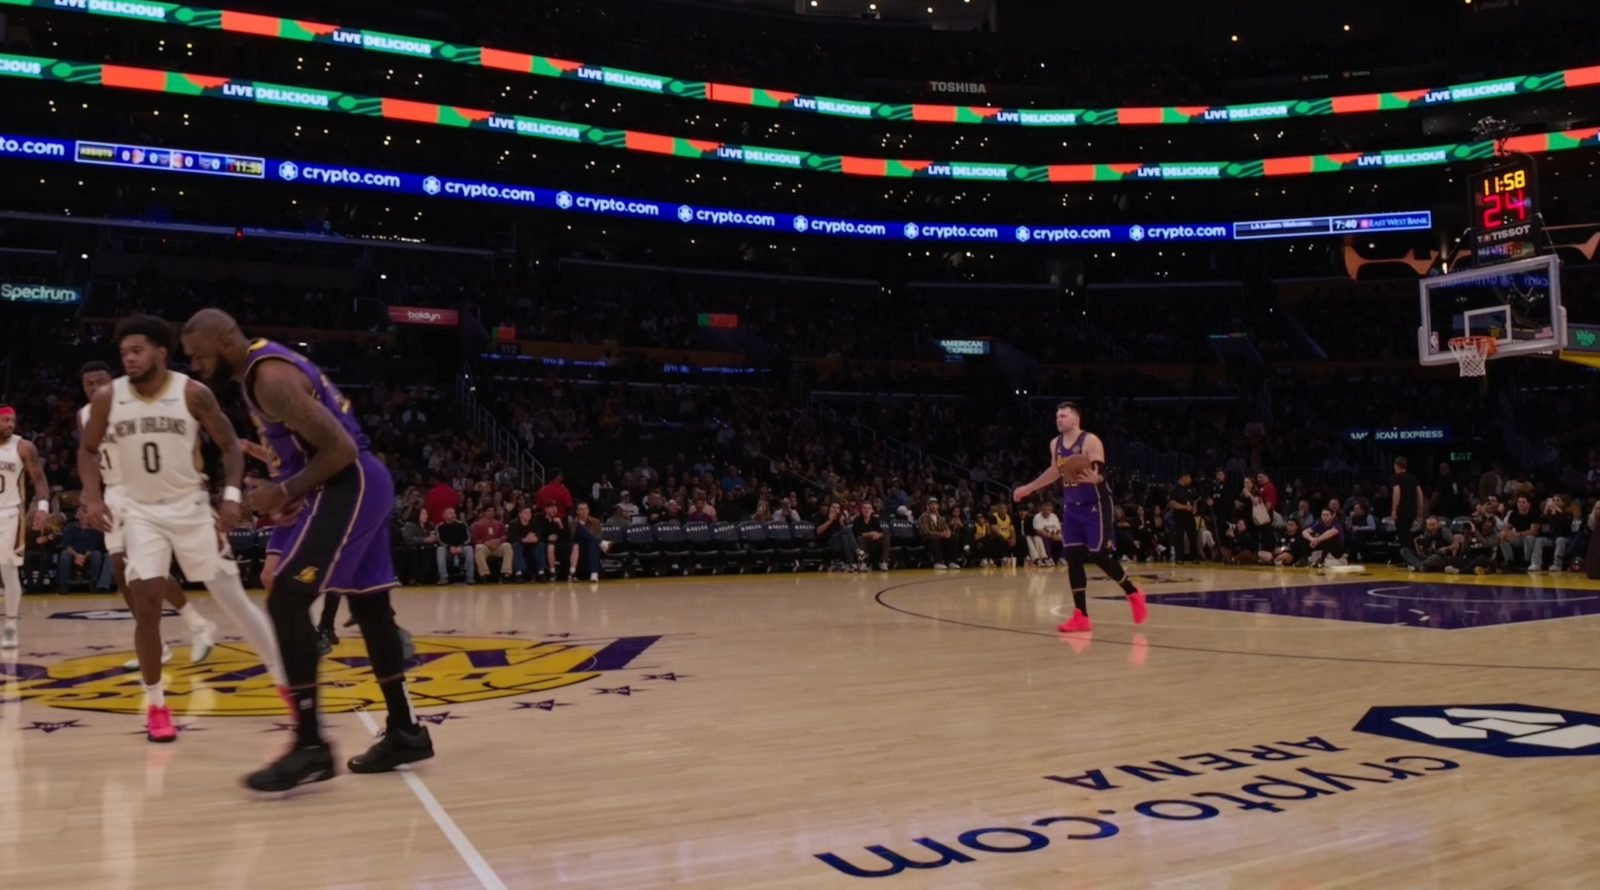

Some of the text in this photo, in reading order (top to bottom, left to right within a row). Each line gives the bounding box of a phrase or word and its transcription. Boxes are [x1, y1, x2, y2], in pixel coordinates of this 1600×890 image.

[88, 0, 165, 18] DELICIOUS
[332, 29, 431, 54] LIVE DELICIOUS
[577, 66, 662, 91] LIVE DELICIOUS
[930, 81, 986, 94] TOSHIBA
[223, 82, 329, 107] LIVE DELICIOUS
[1424, 81, 1516, 103] LIVE DELICIOUS
[793, 96, 871, 116] LIVE DELICIOUS
[1204, 104, 1288, 120] LIVE DELICIOUS
[996, 111, 1076, 124] LIVE DELICIOUS
[488, 116, 580, 139] LIVE DELICIOUS
[720, 147, 801, 166] LIVE DELICIOUS
[1357, 149, 1446, 166] LIVE DELICIOUS
[303, 167, 400, 187] crypto.com
[927, 164, 1008, 178] LIVE DELICIOUS
[1137, 165, 1219, 178] LIVE DELICIOUS
[444, 182, 535, 201] crypto.com
[1484, 169, 1526, 196] 11:58
[577, 196, 659, 215] crypto.com
[1483, 189, 1525, 229] 24
[697, 210, 775, 226] crypto.com
[1370, 216, 1428, 227] EAST WEST BANK
[812, 220, 886, 236] crypto.com
[922, 225, 998, 239] crypto.com
[1033, 228, 1111, 241] crypto.com
[1148, 226, 1226, 239] crypto.com
[1491, 224, 1531, 241] TISSOT
[1, 283, 77, 301] Spectrum
[114, 418, 137, 438] NEW
[139, 416, 187, 436] ORLEANS
[1400, 430, 1444, 439] EXPRESS
[143, 442, 161, 474] 0
[1044, 735, 1348, 791] ARENA
[814, 755, 1459, 878] crypto.com
